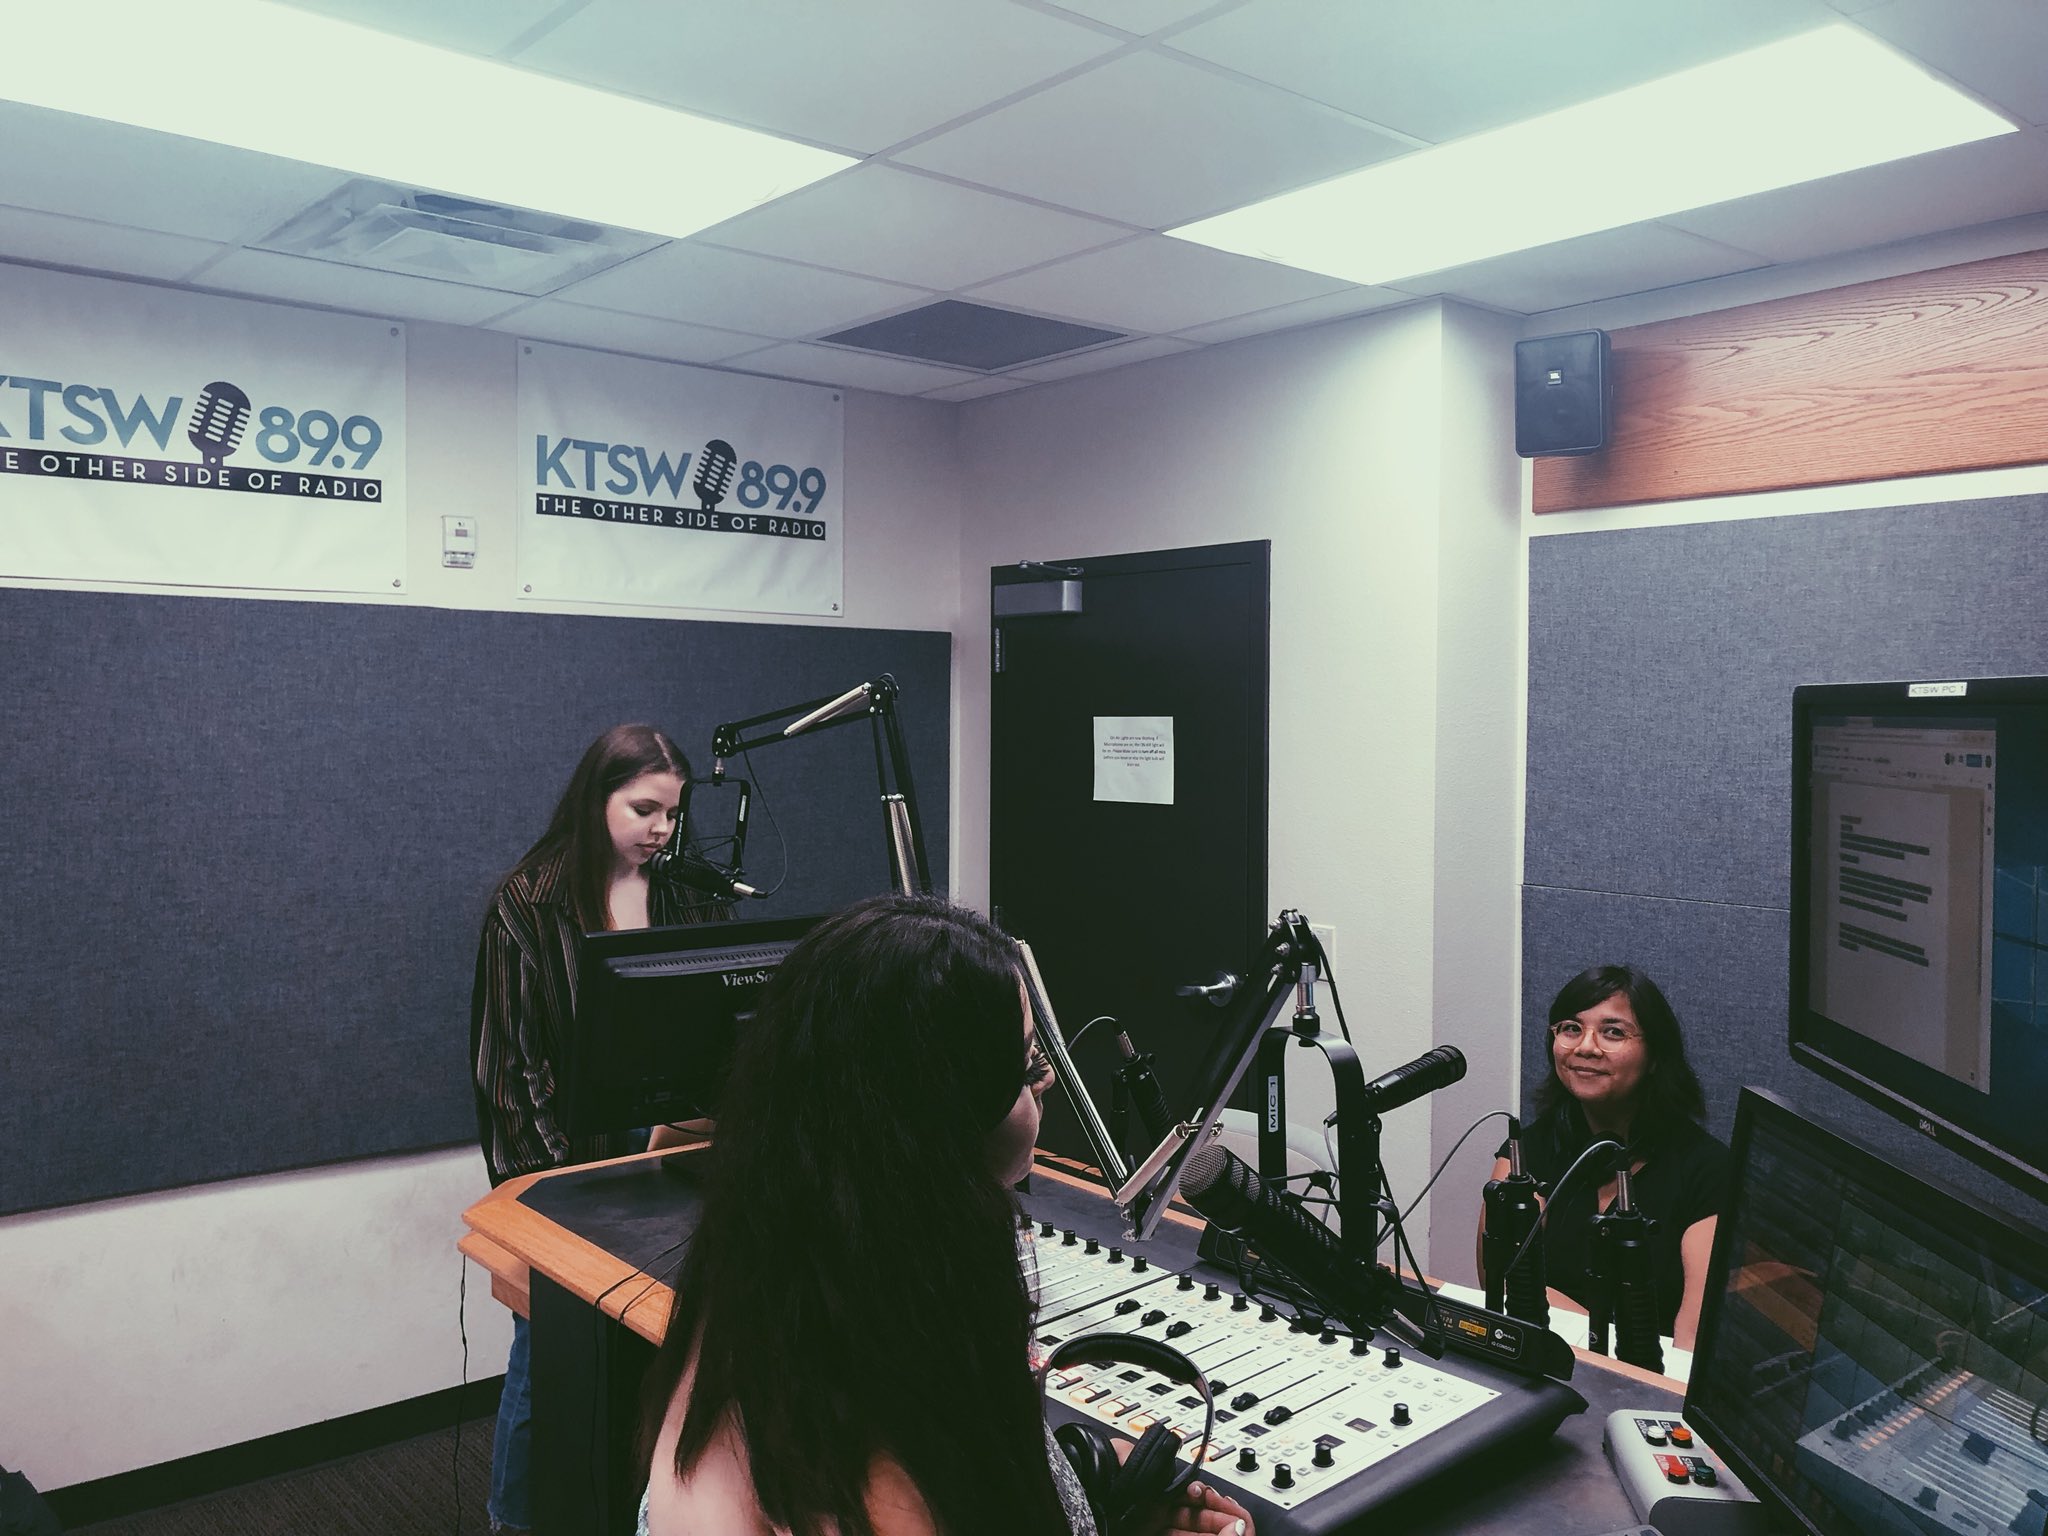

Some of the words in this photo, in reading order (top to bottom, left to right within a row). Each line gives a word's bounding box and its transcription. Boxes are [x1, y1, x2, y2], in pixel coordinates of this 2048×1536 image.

[0, 375, 183, 452] TSW
[255, 406, 383, 470] 89.9
[40, 454, 146, 480] OTHER
[164, 465, 231, 487] SIDE
[247, 472, 282, 491] OF
[300, 477, 380, 499] RADIO
[536, 434, 692, 500] KTSW
[736, 460, 827, 514] 89.9
[538, 496, 582, 515] THE
[592, 502, 664, 524] OTHER
[675, 510, 720, 529] SIDE
[731, 516, 758, 532] OF
[768, 519, 824, 538] RADIO
[1911, 686, 1940, 695] KTSW
[1942, 685, 1957, 694] PC
[1269, 1095, 1277, 1128] MIC
